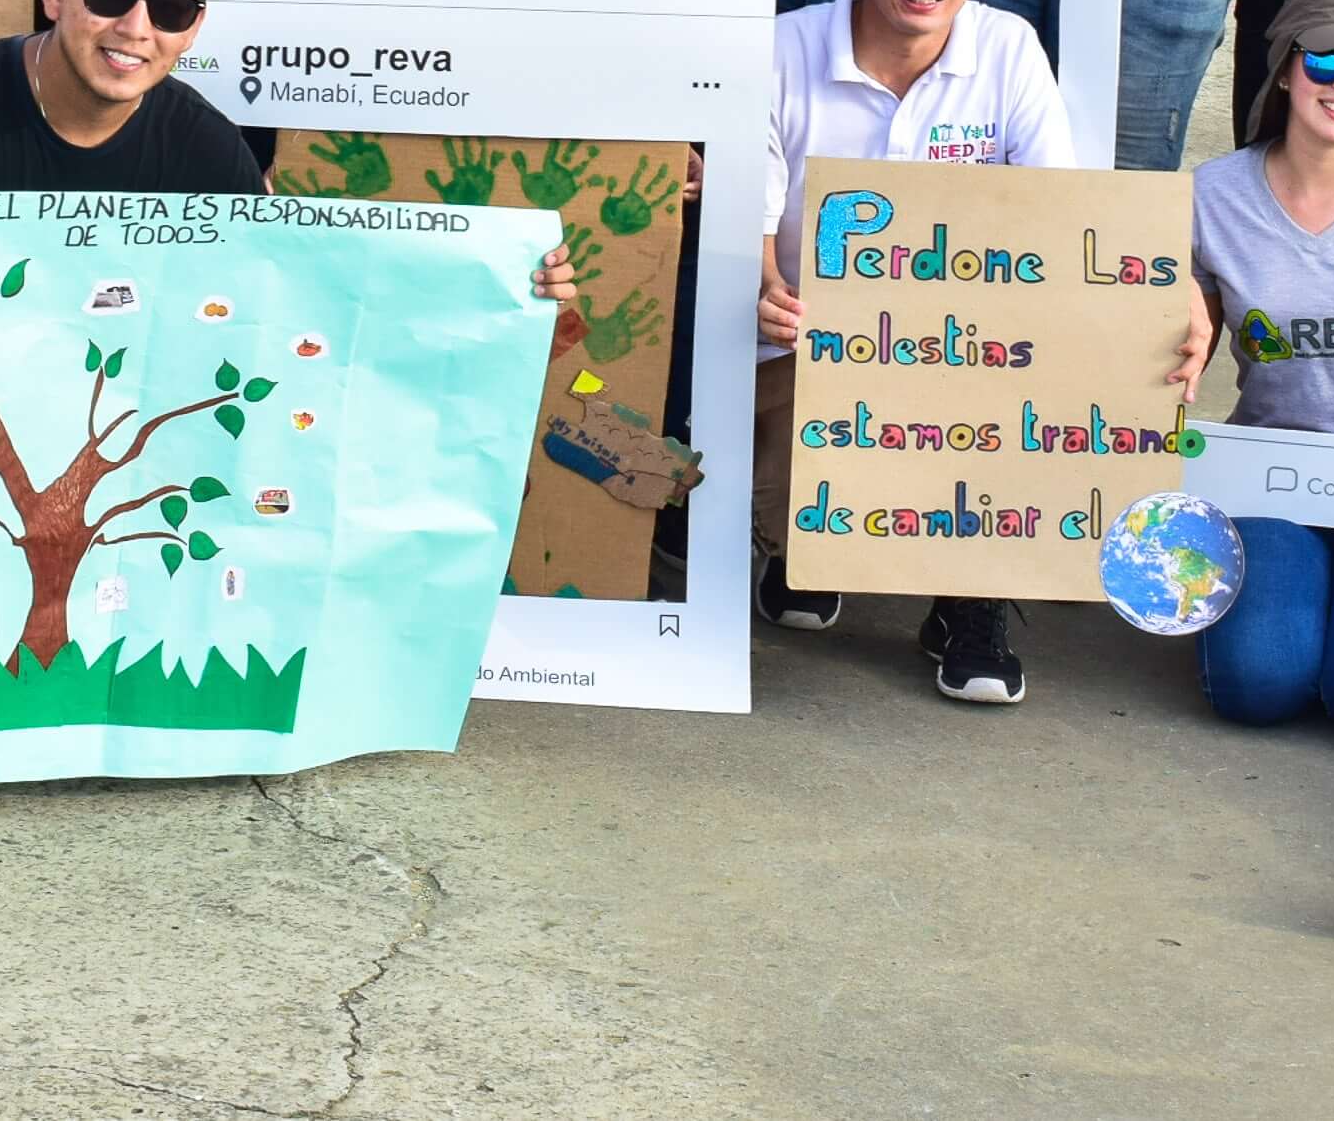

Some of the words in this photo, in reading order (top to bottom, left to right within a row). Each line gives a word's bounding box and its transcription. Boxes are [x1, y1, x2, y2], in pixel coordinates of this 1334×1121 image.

[178, 55, 219, 70] REVA
[241, 42, 452, 77] grupo_reva
[270, 81, 364, 106] Manabí,
[373, 83, 470, 108] Ecuador
[928, 143, 974, 160] NEED
[38, 192, 169, 221] PLANETA
[183, 193, 219, 222] ES
[65, 224, 98, 247] DE
[121, 223, 226, 246] TODOS.
[815, 189, 1046, 284] Perdone
[1083, 228, 1179, 286] Las
[805, 311, 1035, 368] molestias
[800, 401, 1002, 451] estamos
[1021, 401, 1207, 458] tratando
[795, 480, 854, 536] de
[863, 480, 1042, 538] cambiar
[1059, 488, 1103, 540] el
[499, 666, 595, 687] Ambiental
